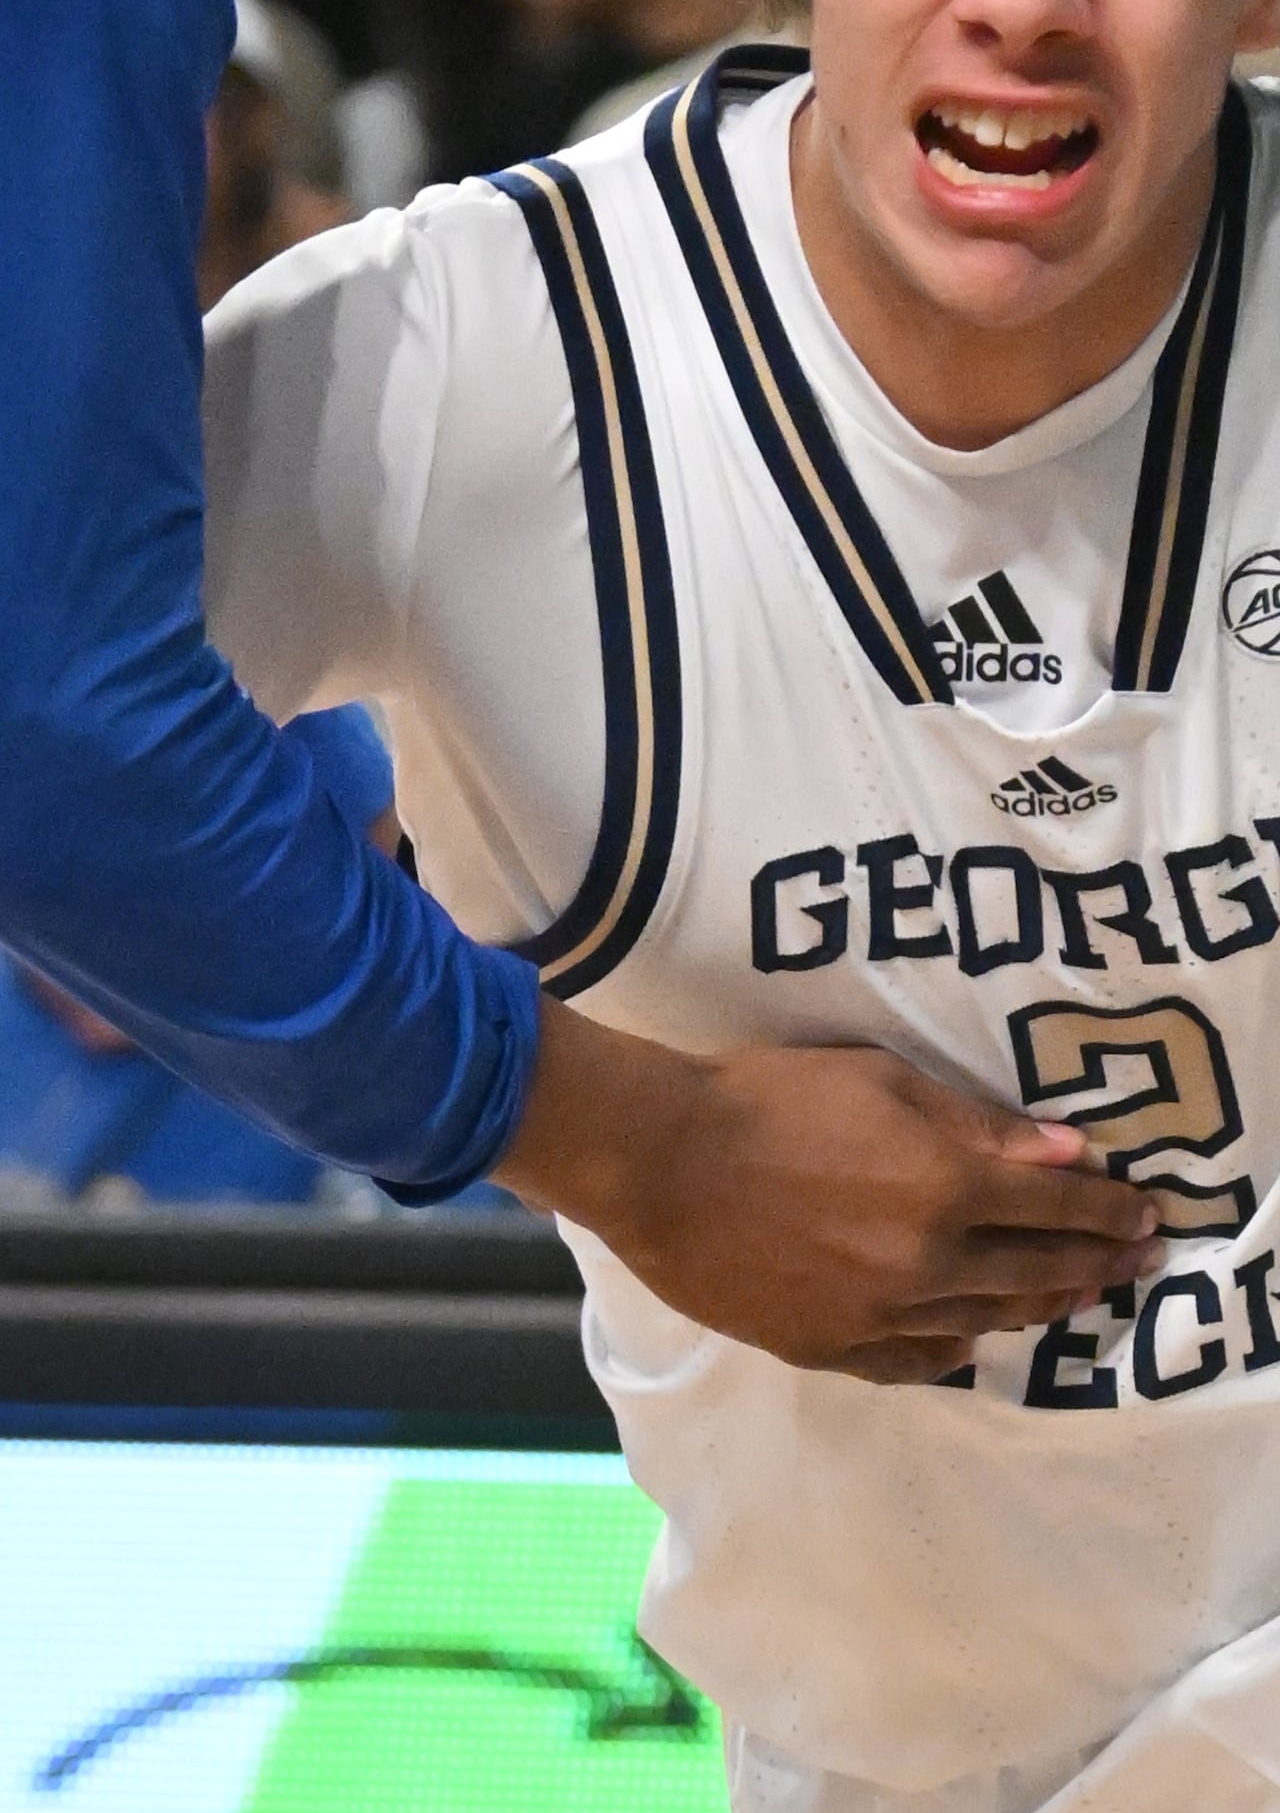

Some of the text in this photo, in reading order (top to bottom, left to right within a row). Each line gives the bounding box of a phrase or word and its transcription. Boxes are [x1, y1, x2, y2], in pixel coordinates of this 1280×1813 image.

[934, 641, 1063, 685] didas
[990, 784, 1119, 818] adidas
[1006, 995, 1259, 1240] 2
